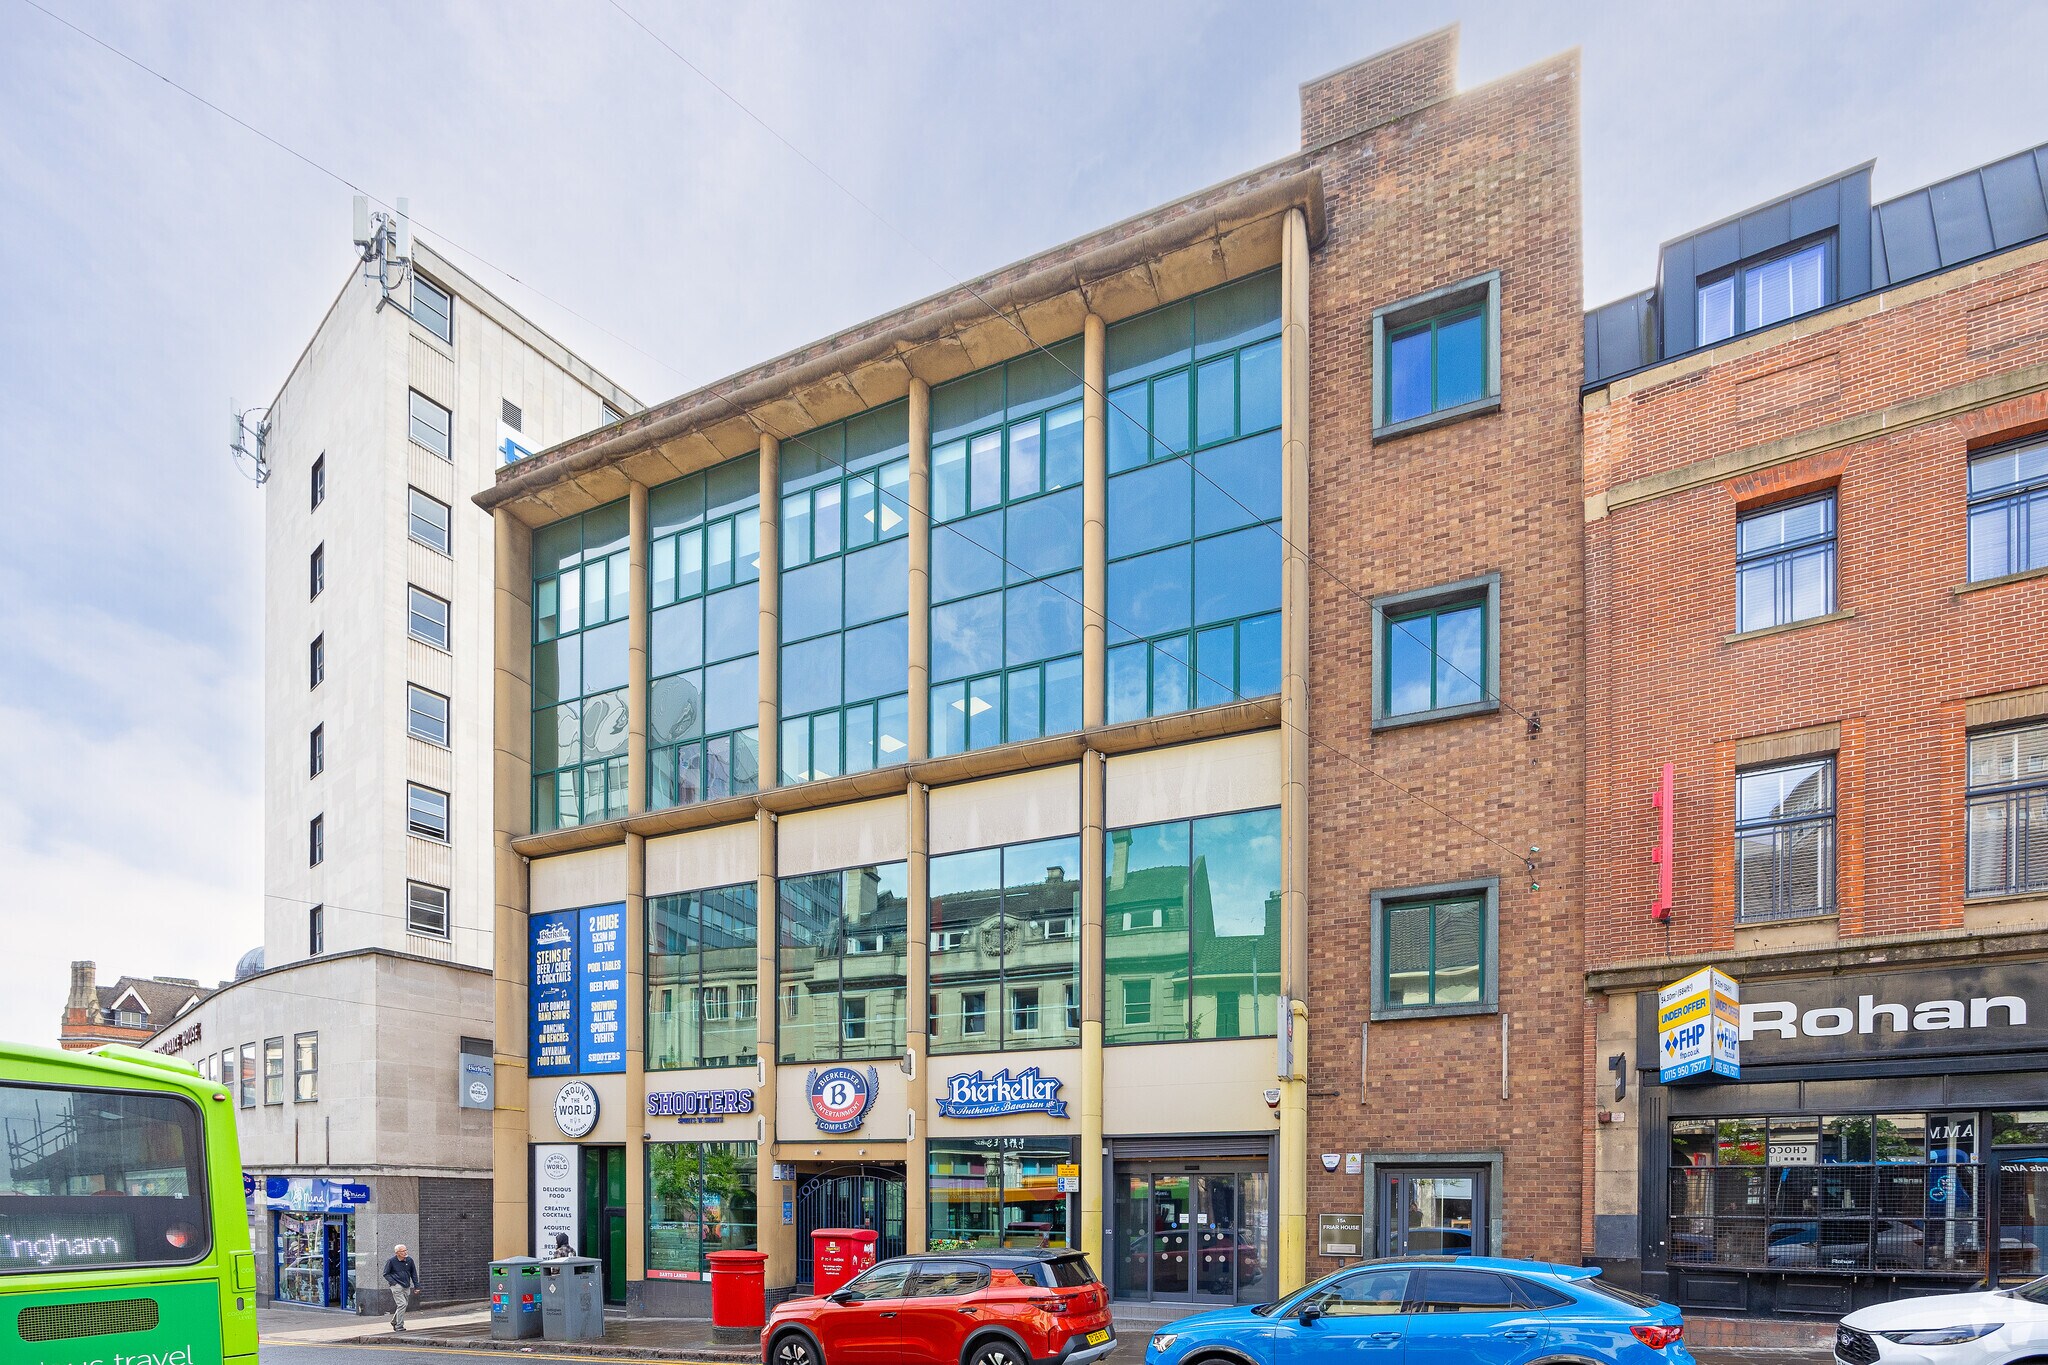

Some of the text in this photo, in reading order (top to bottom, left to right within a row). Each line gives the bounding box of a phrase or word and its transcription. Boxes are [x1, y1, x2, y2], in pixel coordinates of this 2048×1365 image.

[590, 914, 619, 932] 2 HUGE
[594, 942, 614, 953] LED TVS
[536, 948, 572, 964] STEINS OF
[536, 964, 550, 974] BEER
[555, 961, 572, 972] CIDER
[588, 960, 621, 973] POOL TABLES
[542, 972, 572, 984] COCKTAILS
[590, 980, 619, 992] BEER PONG
[538, 1000, 570, 1012] LIVE OOMPAH
[591, 1000, 618, 1012] SHOWING
[1662, 998, 1706, 1024] UNDER OFFER
[538, 1010, 570, 1022] BAND SHOWS
[594, 1011, 615, 1022] ALL LIVE
[1739, 995, 2027, 1041] Rohan
[543, 1024, 565, 1034] DANCING
[590, 1022, 618, 1033] SPORTING
[538, 1033, 569, 1044] ON BENCHES
[594, 1032, 614, 1044] EVENTS
[1679, 1024, 1705, 1050] FHP
[1725, 1027, 1737, 1050] FHP
[542, 1046, 566, 1056] BAVARIAN
[588, 1052, 620, 1062] SHOOTERS
[537, 1056, 549, 1066] FOOD
[555, 1055, 571, 1065] DRINK
[1664, 1060, 1707, 1080] 0115 950 7577
[818, 1072, 860, 1086] BIERKELLER
[561, 1086, 590, 1102] AROUND
[830, 1083, 846, 1106] B
[952, 1074, 1056, 1103] Bierkeller
[646, 1088, 754, 1116] SHOOTERS
[956, 1100, 1043, 1115] Authentic Bavarian
[559, 1105, 592, 1115] WORLD
[816, 1101, 860, 1118] ENTERTAINMENT
[820, 1121, 853, 1130] COMPLEX
[4, 1233, 119, 1264] ngham
